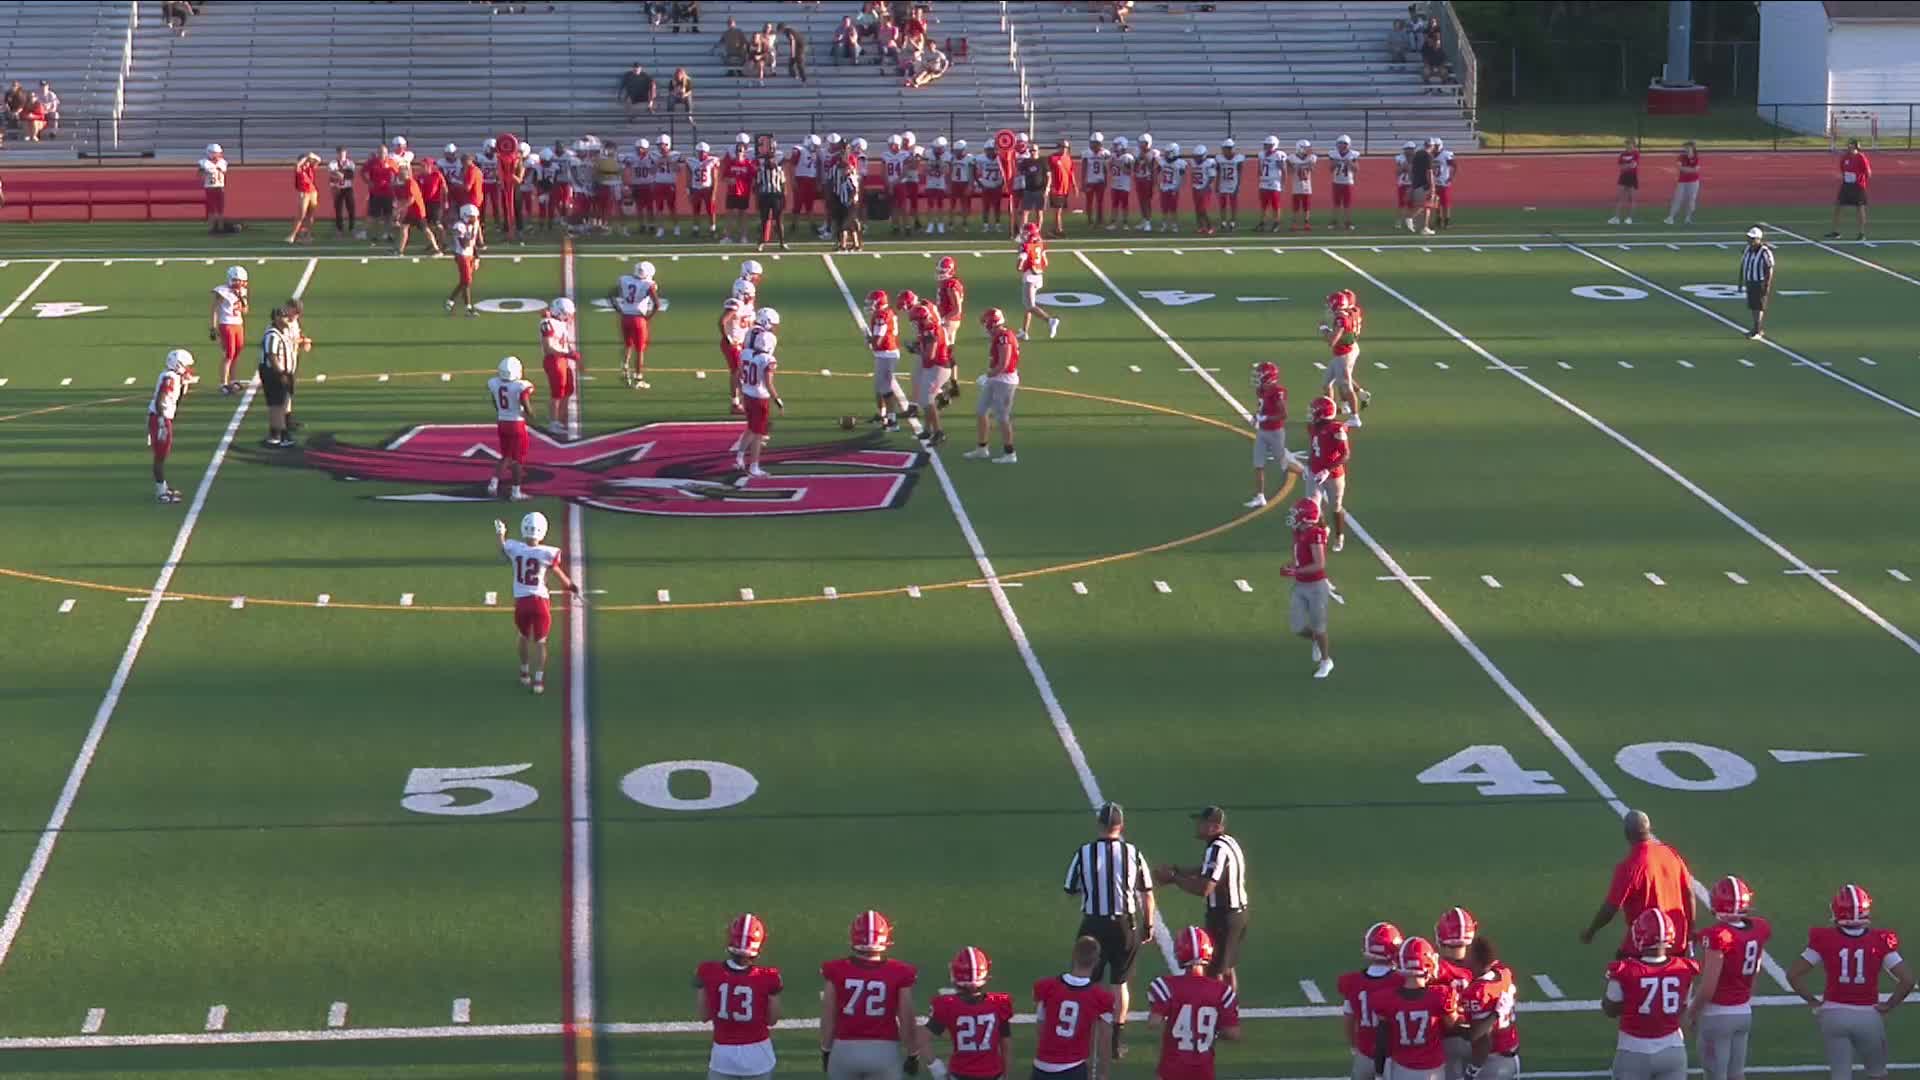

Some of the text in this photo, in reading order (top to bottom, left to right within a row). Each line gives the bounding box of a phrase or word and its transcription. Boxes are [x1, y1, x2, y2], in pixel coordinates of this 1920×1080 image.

[626, 283, 637, 305] 3
[498, 385, 510, 409] 6
[515, 554, 540, 587] 12
[1742, 939, 1758, 976] 8
[1838, 948, 1866, 984] 11
[717, 982, 753, 1022] 13
[842, 978, 887, 1016] 72
[1637, 976, 1681, 1015] 76
[956, 1014, 996, 1051] 27
[1055, 1000, 1080, 1037] 9
[1171, 1003, 1218, 1053] 49
[1395, 1009, 1429, 1045] 17
